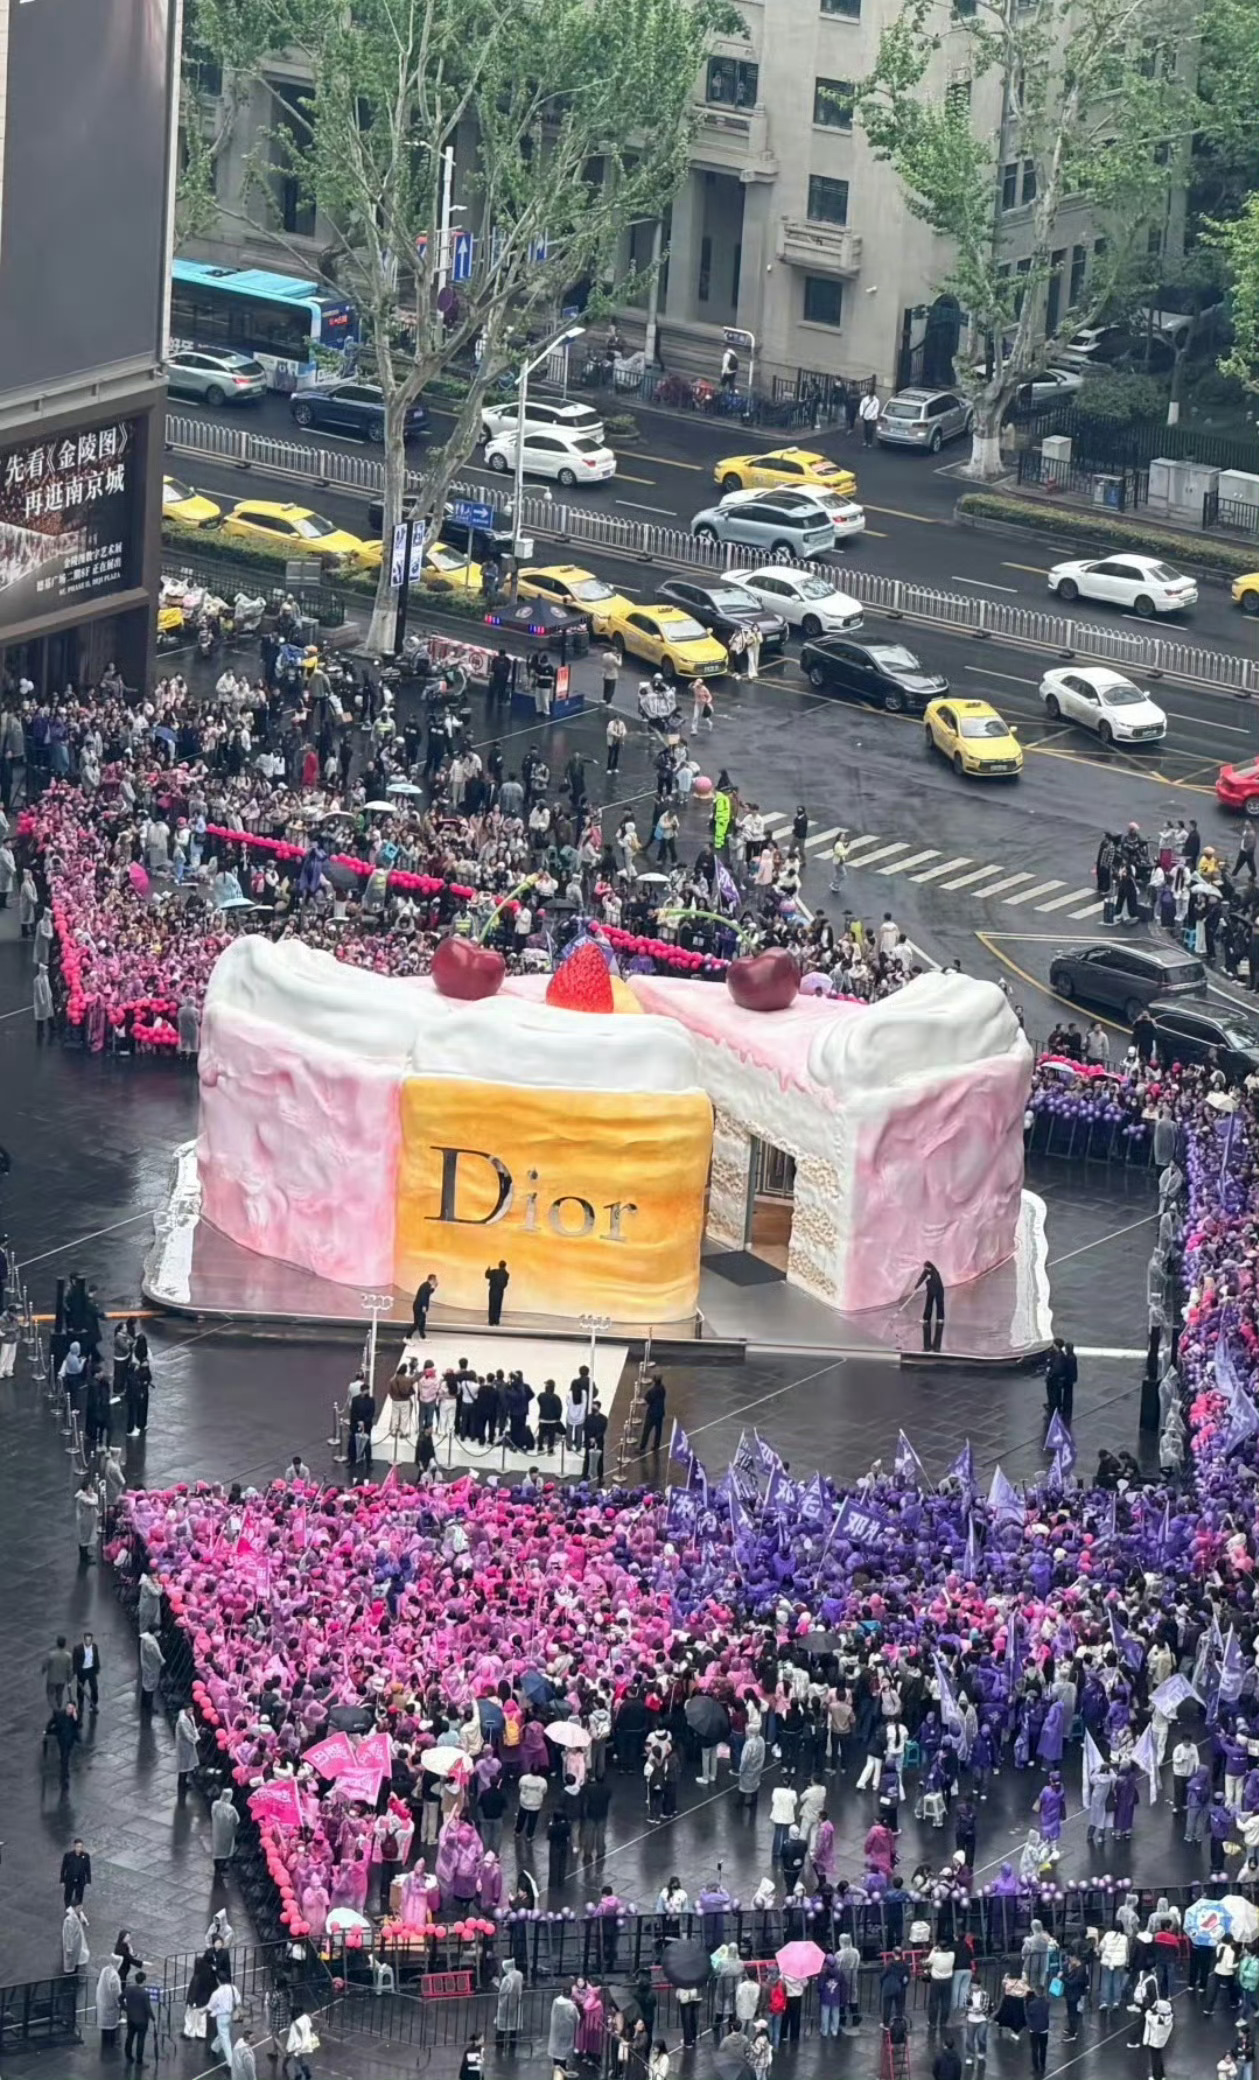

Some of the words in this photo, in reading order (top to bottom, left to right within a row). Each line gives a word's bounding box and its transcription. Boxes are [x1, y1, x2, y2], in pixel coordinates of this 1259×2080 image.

[4, 422, 128, 487] 先看《金陵图》
[24, 463, 125, 519] 再逛南京城
[424, 1146, 638, 1241] Dior
